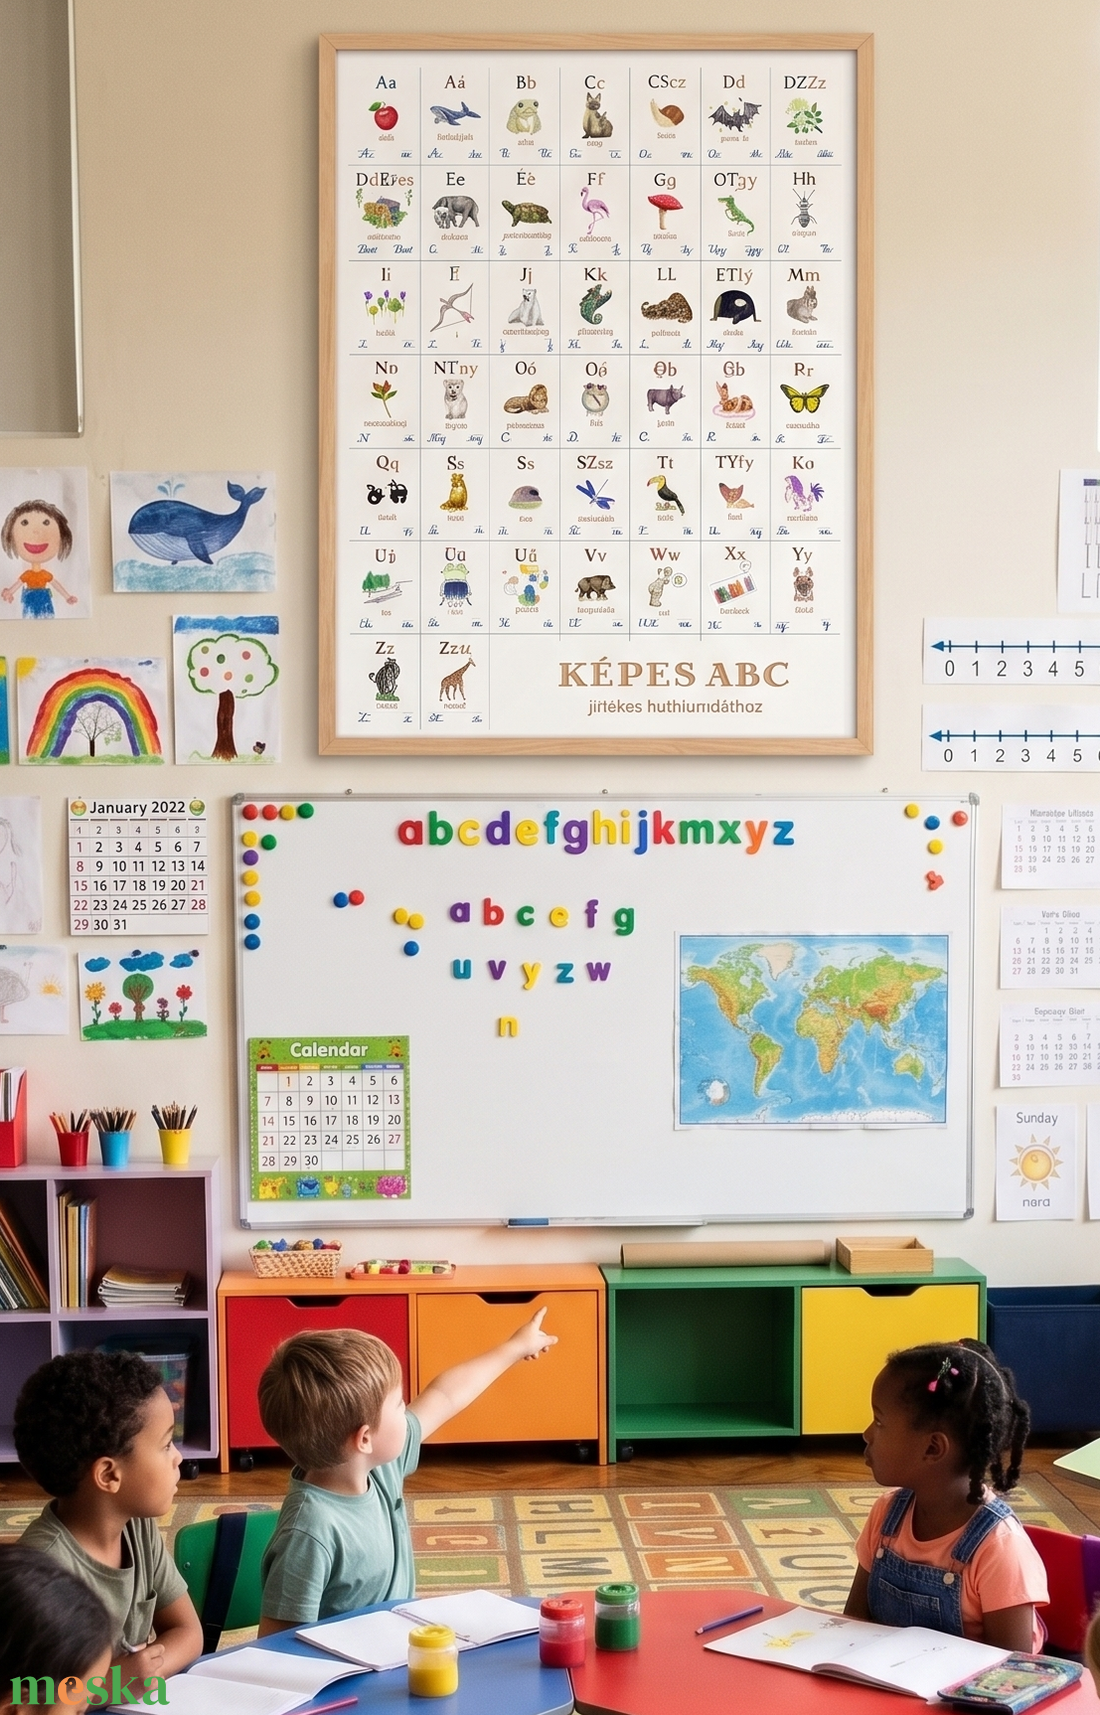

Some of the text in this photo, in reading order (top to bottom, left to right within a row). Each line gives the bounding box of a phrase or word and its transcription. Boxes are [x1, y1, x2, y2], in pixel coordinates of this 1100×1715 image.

[375, 76, 396, 89] Aa
[444, 75, 465, 88] Aá
[516, 76, 536, 89] Bb
[584, 75, 604, 89] Cc
[649, 75, 685, 88] CScz
[723, 75, 744, 88] Dd
[785, 76, 825, 89] DZZz
[446, 172, 465, 185] Ee
[516, 169, 535, 185] Éé
[587, 173, 605, 185] Ff
[653, 173, 675, 189] Gg
[793, 172, 815, 185] Hh
[519, 268, 531, 284] Jj
[584, 268, 607, 281] Kk
[657, 268, 676, 280] LL
[787, 269, 819, 281] Mm
[515, 361, 536, 375] Oó
[794, 363, 813, 376] Rr
[376, 455, 398, 472] Qq
[447, 456, 464, 470] Ss
[517, 456, 534, 469] Ss
[577, 456, 612, 469] SZsz
[656, 456, 673, 469] Tt
[715, 455, 753, 472] TYfy
[792, 456, 814, 469] Ko
[584, 549, 606, 561] Vv
[649, 548, 680, 561] Ww
[724, 547, 746, 560] Xx
[792, 547, 812, 564] Yy
[375, 642, 394, 654] Zz
[559, 656, 789, 687] KÉPES ABC
[944, 660, 1084, 677] 0 1 2 3 4 5
[943, 749, 1082, 762] 0 1 2 3 4 5
[90, 801, 185, 817] January 2022
[96, 826, 102, 834] 2
[116, 826, 122, 834] 3
[155, 826, 161, 834] 5
[76, 841, 201, 852] 1 2 3 4 5 6 7
[76, 860, 204, 872] 8 9 10 11 12 13 14
[73, 880, 203, 891] 15 16 17 18 19 20 21
[73, 899, 206, 910] 22 23 24 25 26 27 28
[450, 898, 635, 935] a b c e f g
[73, 919, 126, 930] 29 30 31
[1043, 937, 1051, 945] 8
[452, 958, 611, 990] u v y z w
[498, 1016, 517, 1037] n
[290, 1042, 368, 1057] Calendar
[306, 1076, 313, 1086] 2
[327, 1076, 334, 1085] 3
[348, 1076, 356, 1085] 4
[369, 1076, 377, 1085] 5
[390, 1076, 398, 1085] 6
[264, 1095, 399, 1106] 7 8 9 10 11 12 13
[262, 1115, 401, 1126] 14 15 16 17 18 19 20
[1017, 1112, 1058, 1126] Sunday
[262, 1134, 400, 1145] 21 22 23 24 25 26 27
[261, 1156, 318, 1166] 28 29 30
